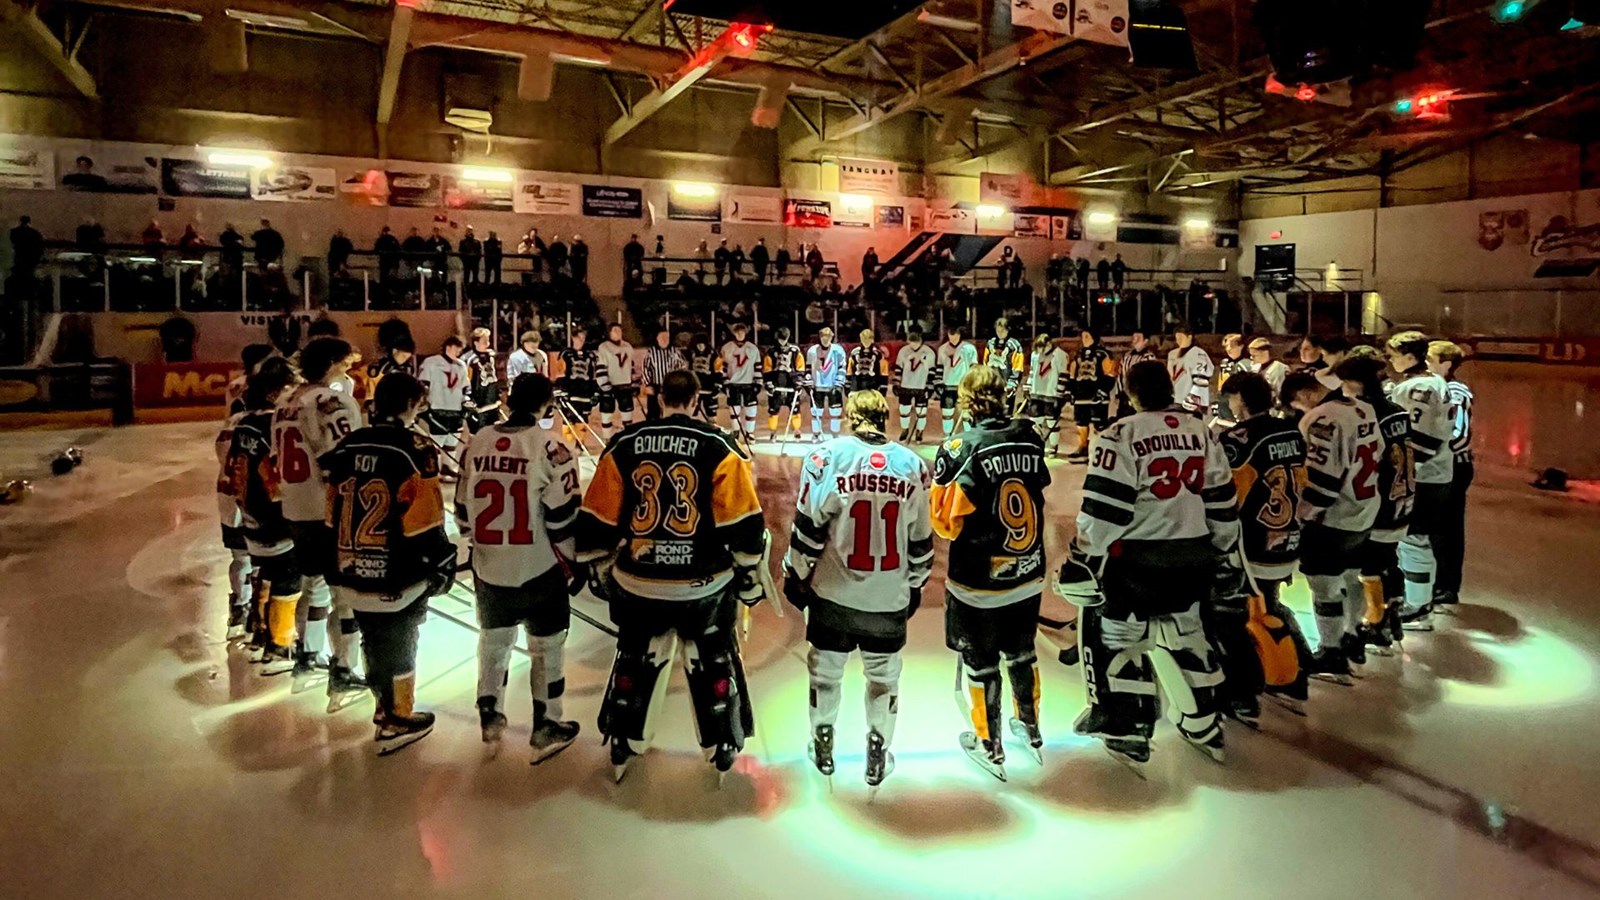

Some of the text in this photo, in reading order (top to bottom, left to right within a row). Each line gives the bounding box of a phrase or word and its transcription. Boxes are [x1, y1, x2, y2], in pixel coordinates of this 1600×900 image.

[841, 164, 894, 176] TANGUAY
[327, 416, 351, 440] 16
[634, 435, 699, 457] BOUCHER
[1092, 446, 1118, 471] 30
[1147, 456, 1206, 500] 30
[561, 468, 580, 494] 21
[630, 460, 701, 537] 33
[338, 476, 391, 551] 12
[474, 479, 534, 545] 21
[999, 477, 1038, 553] 9
[847, 499, 900, 571] 11
[655, 554, 694, 565] POINT
[1083, 646, 1099, 705] CCM
